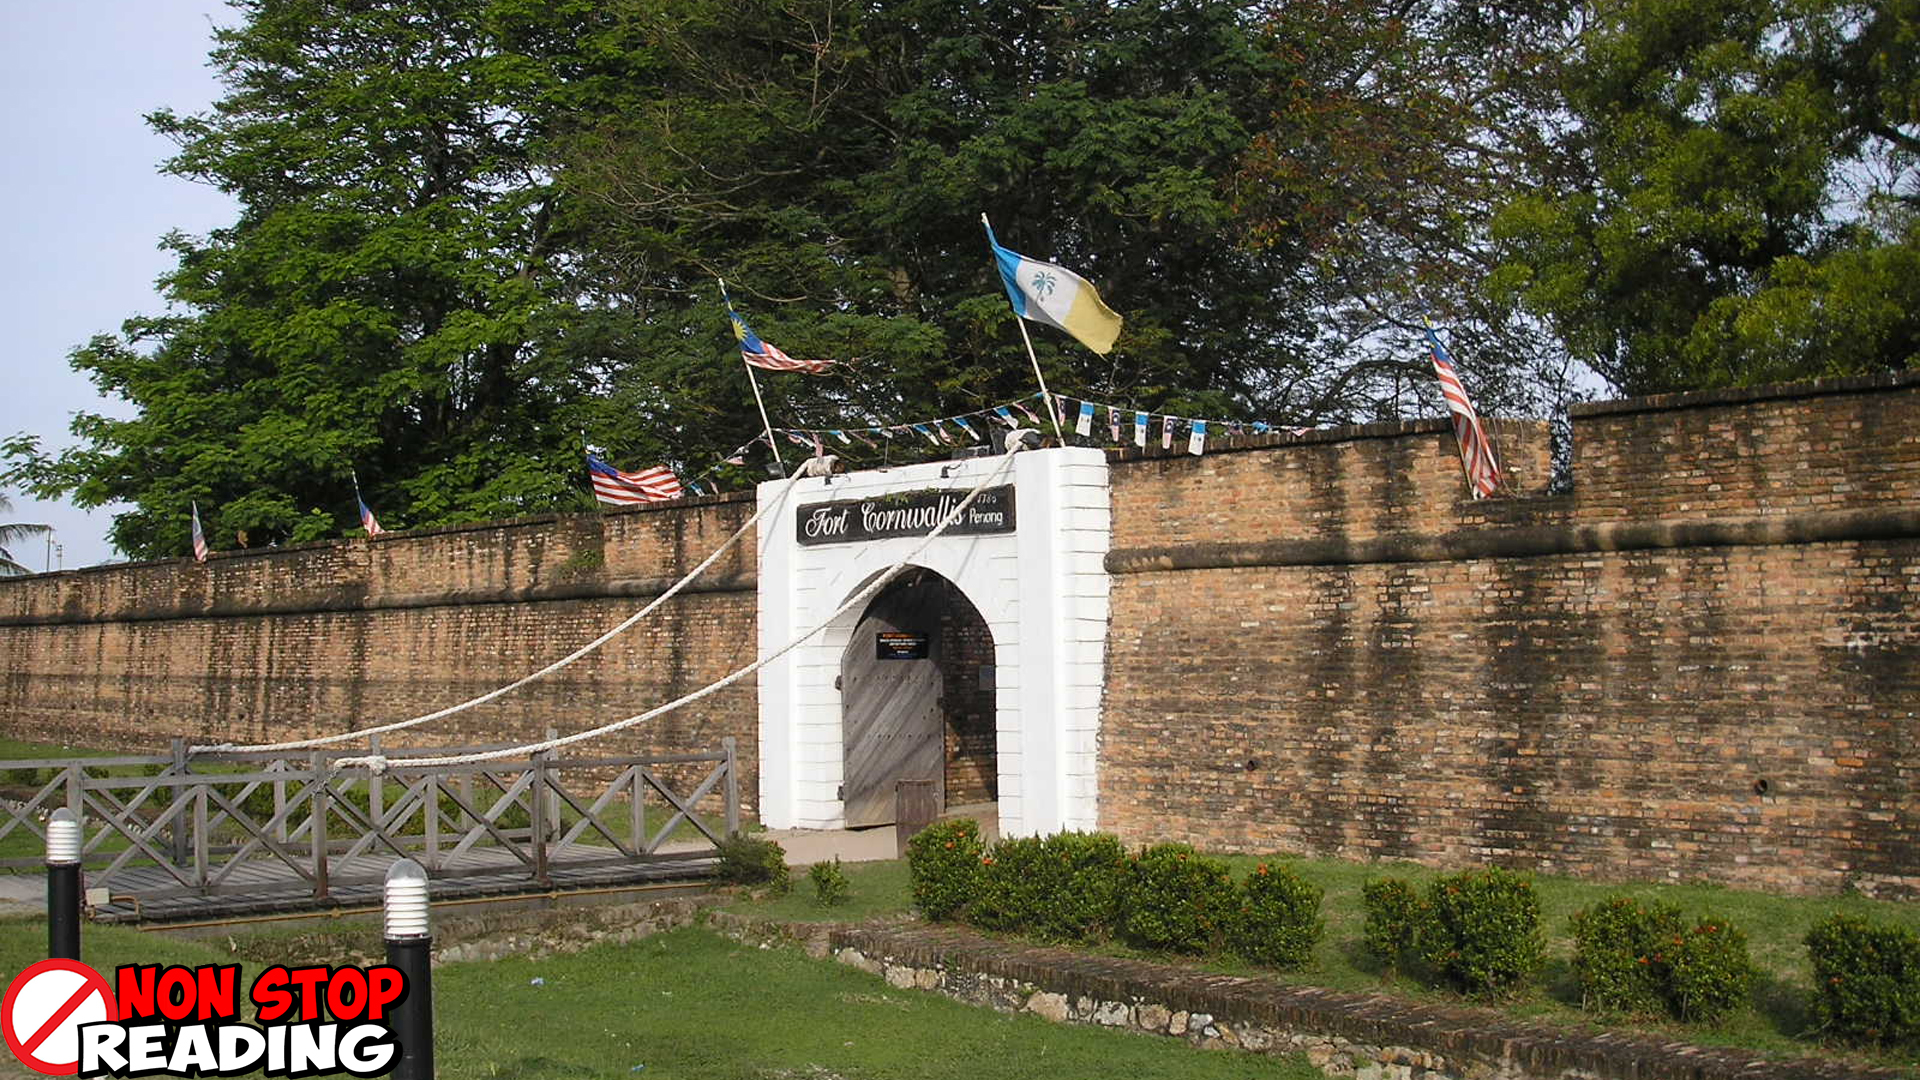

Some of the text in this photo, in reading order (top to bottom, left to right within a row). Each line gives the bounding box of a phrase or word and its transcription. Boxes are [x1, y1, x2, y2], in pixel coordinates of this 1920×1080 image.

[805, 495, 963, 537] Fort Cornwallis
[969, 507, 1003, 526] Penang
